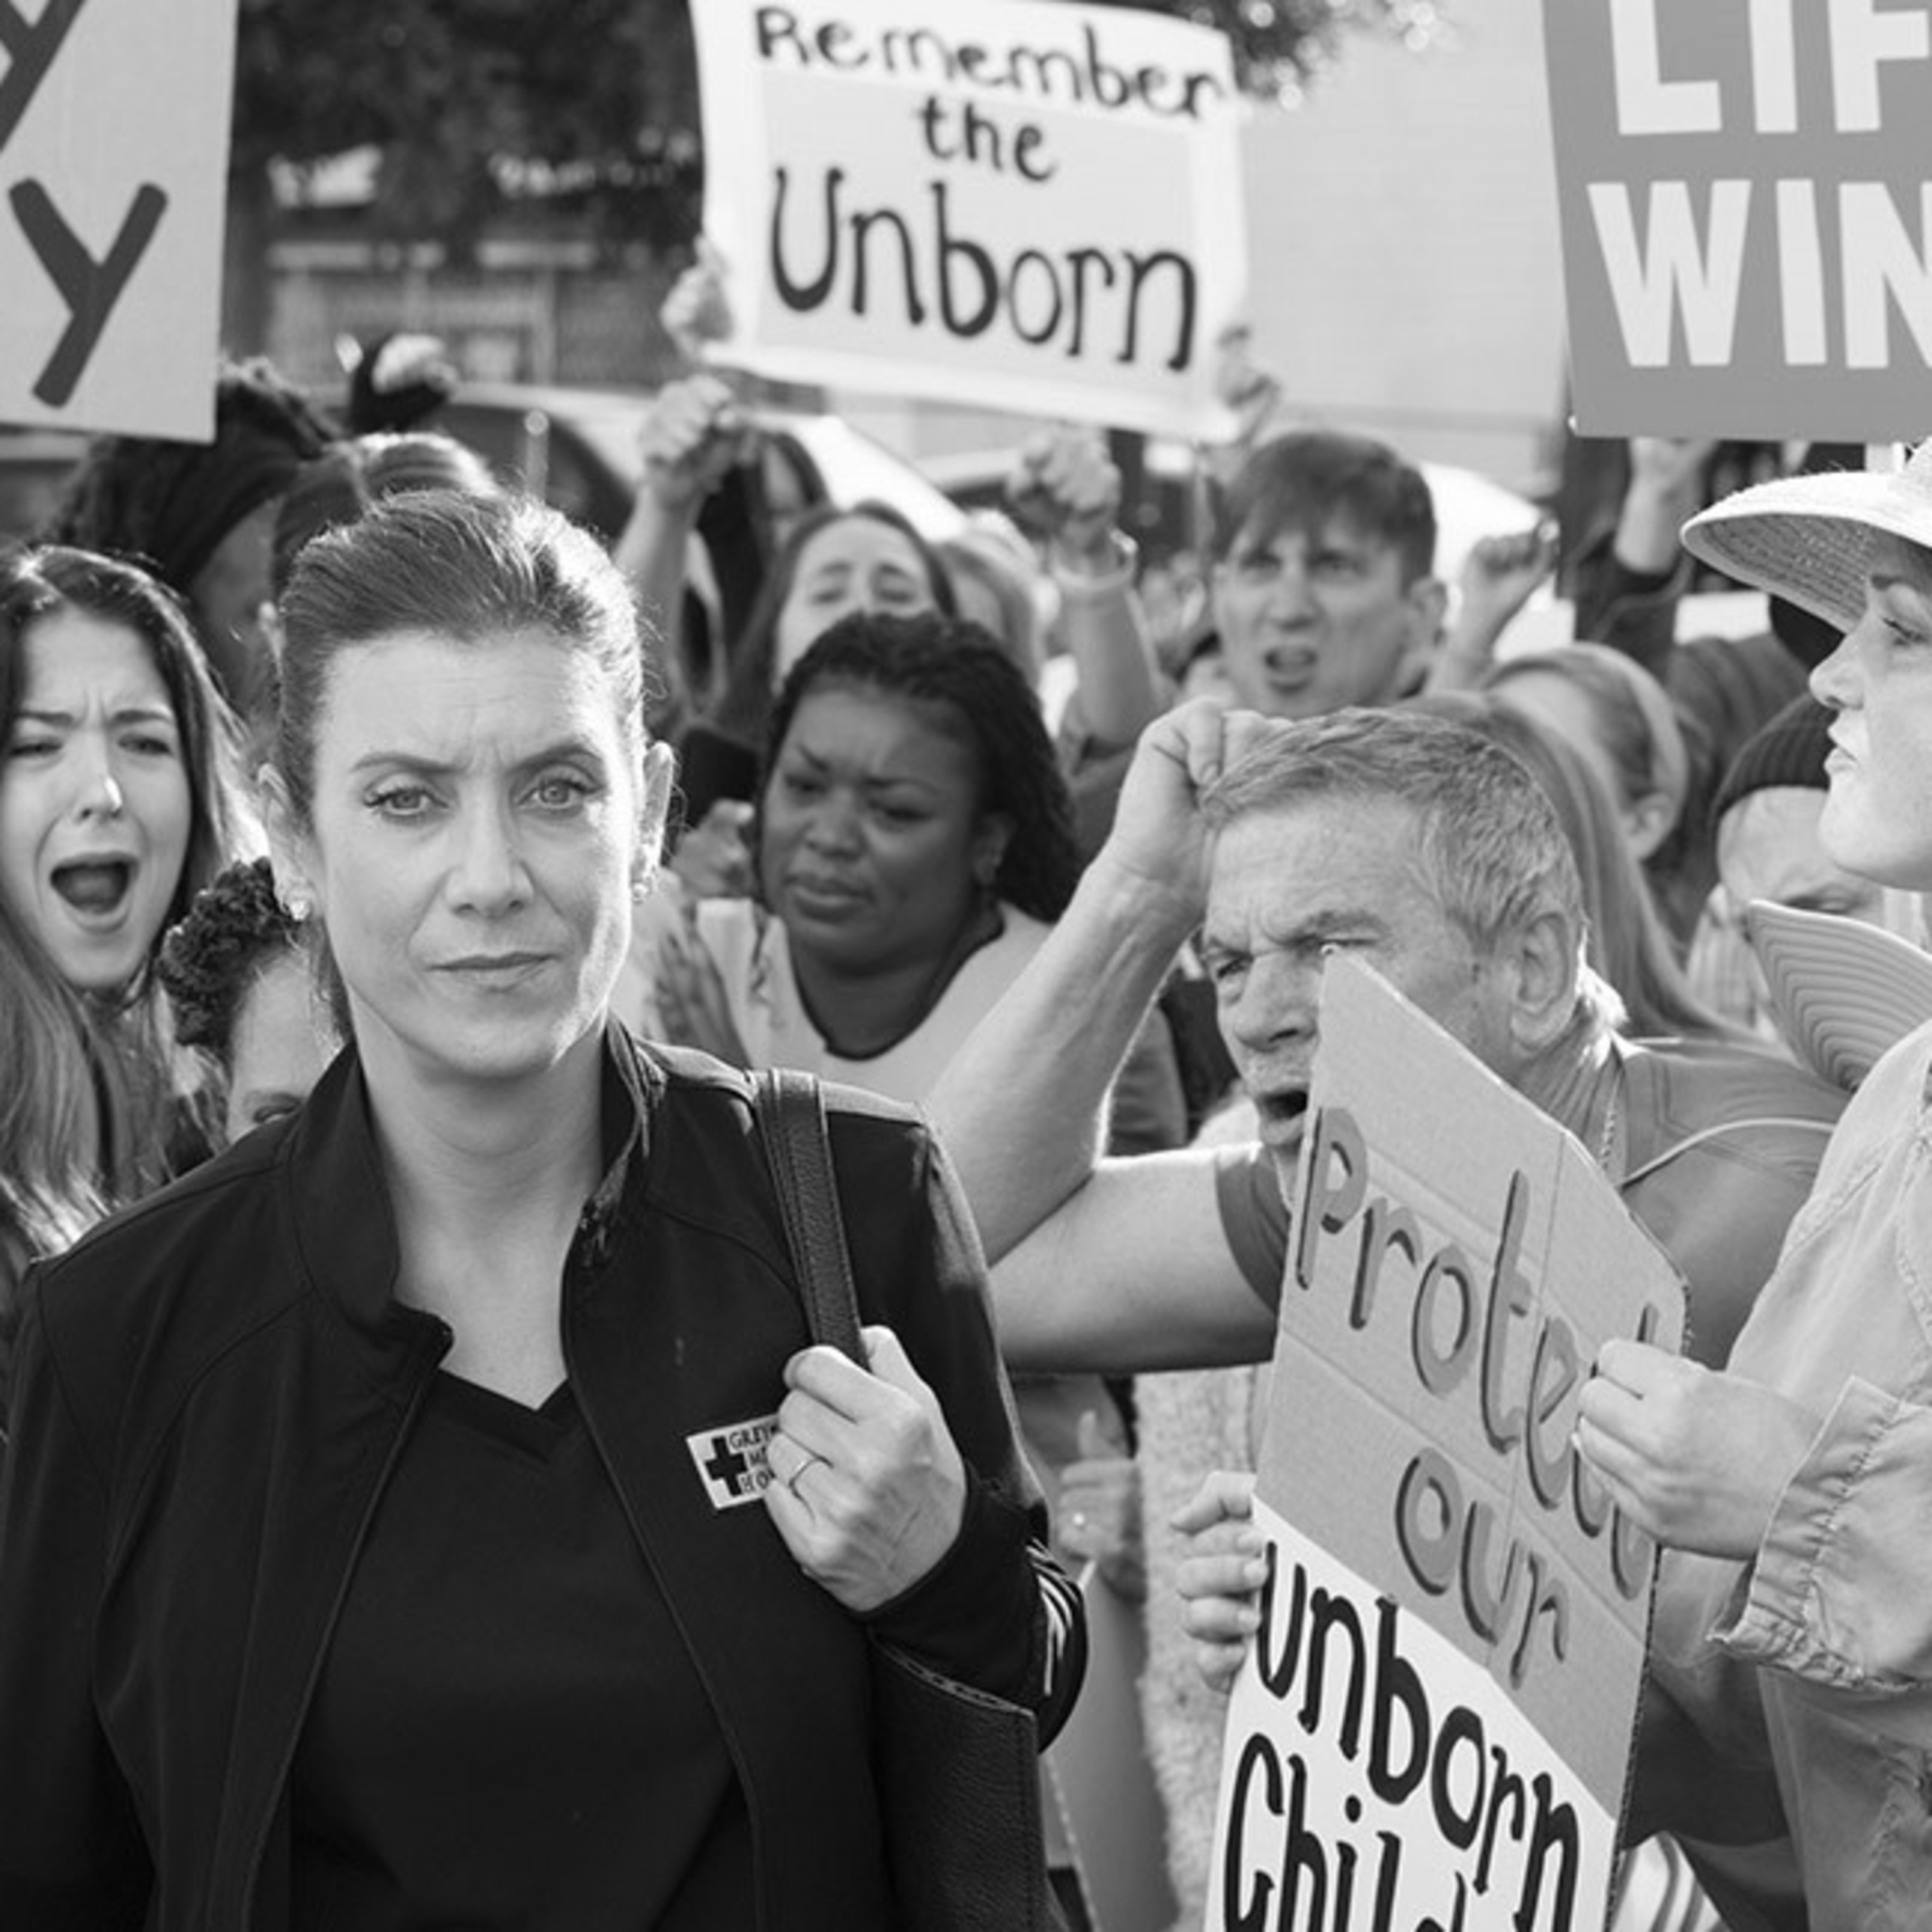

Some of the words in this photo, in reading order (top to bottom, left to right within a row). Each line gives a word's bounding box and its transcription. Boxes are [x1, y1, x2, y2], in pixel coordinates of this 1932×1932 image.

[755, 6, 1222, 118] Remember
[918, 95, 1057, 182] the
[772, 167, 1195, 372] Unborn
[1586, 179, 1932, 368] WIN
[1395, 1446, 1569, 1689] our
